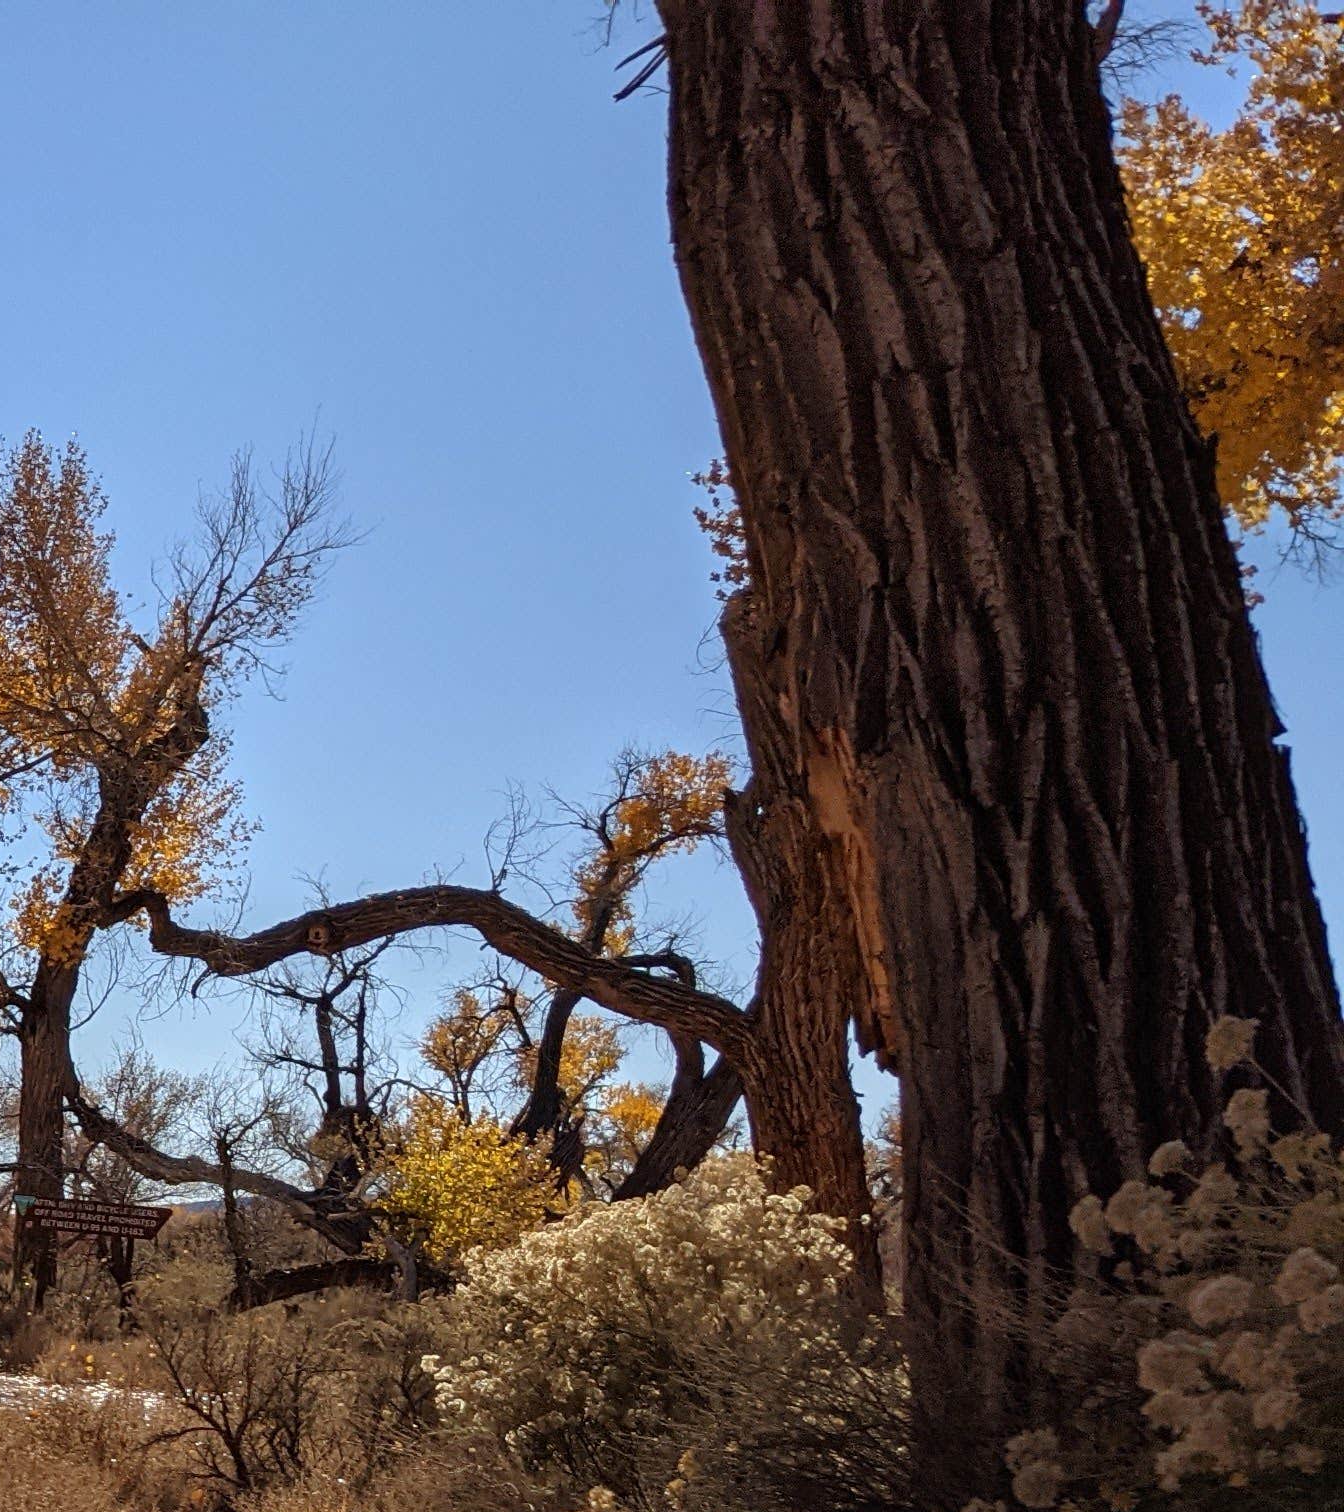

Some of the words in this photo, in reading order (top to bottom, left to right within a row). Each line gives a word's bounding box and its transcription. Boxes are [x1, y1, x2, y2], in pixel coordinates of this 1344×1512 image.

[41, 1218, 80, 1229] BETWEEN
[102, 1225, 119, 1233] AND
[52, 1210, 74, 1219] ROAD
[77, 1212, 106, 1222] TRAVEL
[108, 1216, 156, 1227] PROHIBITED
